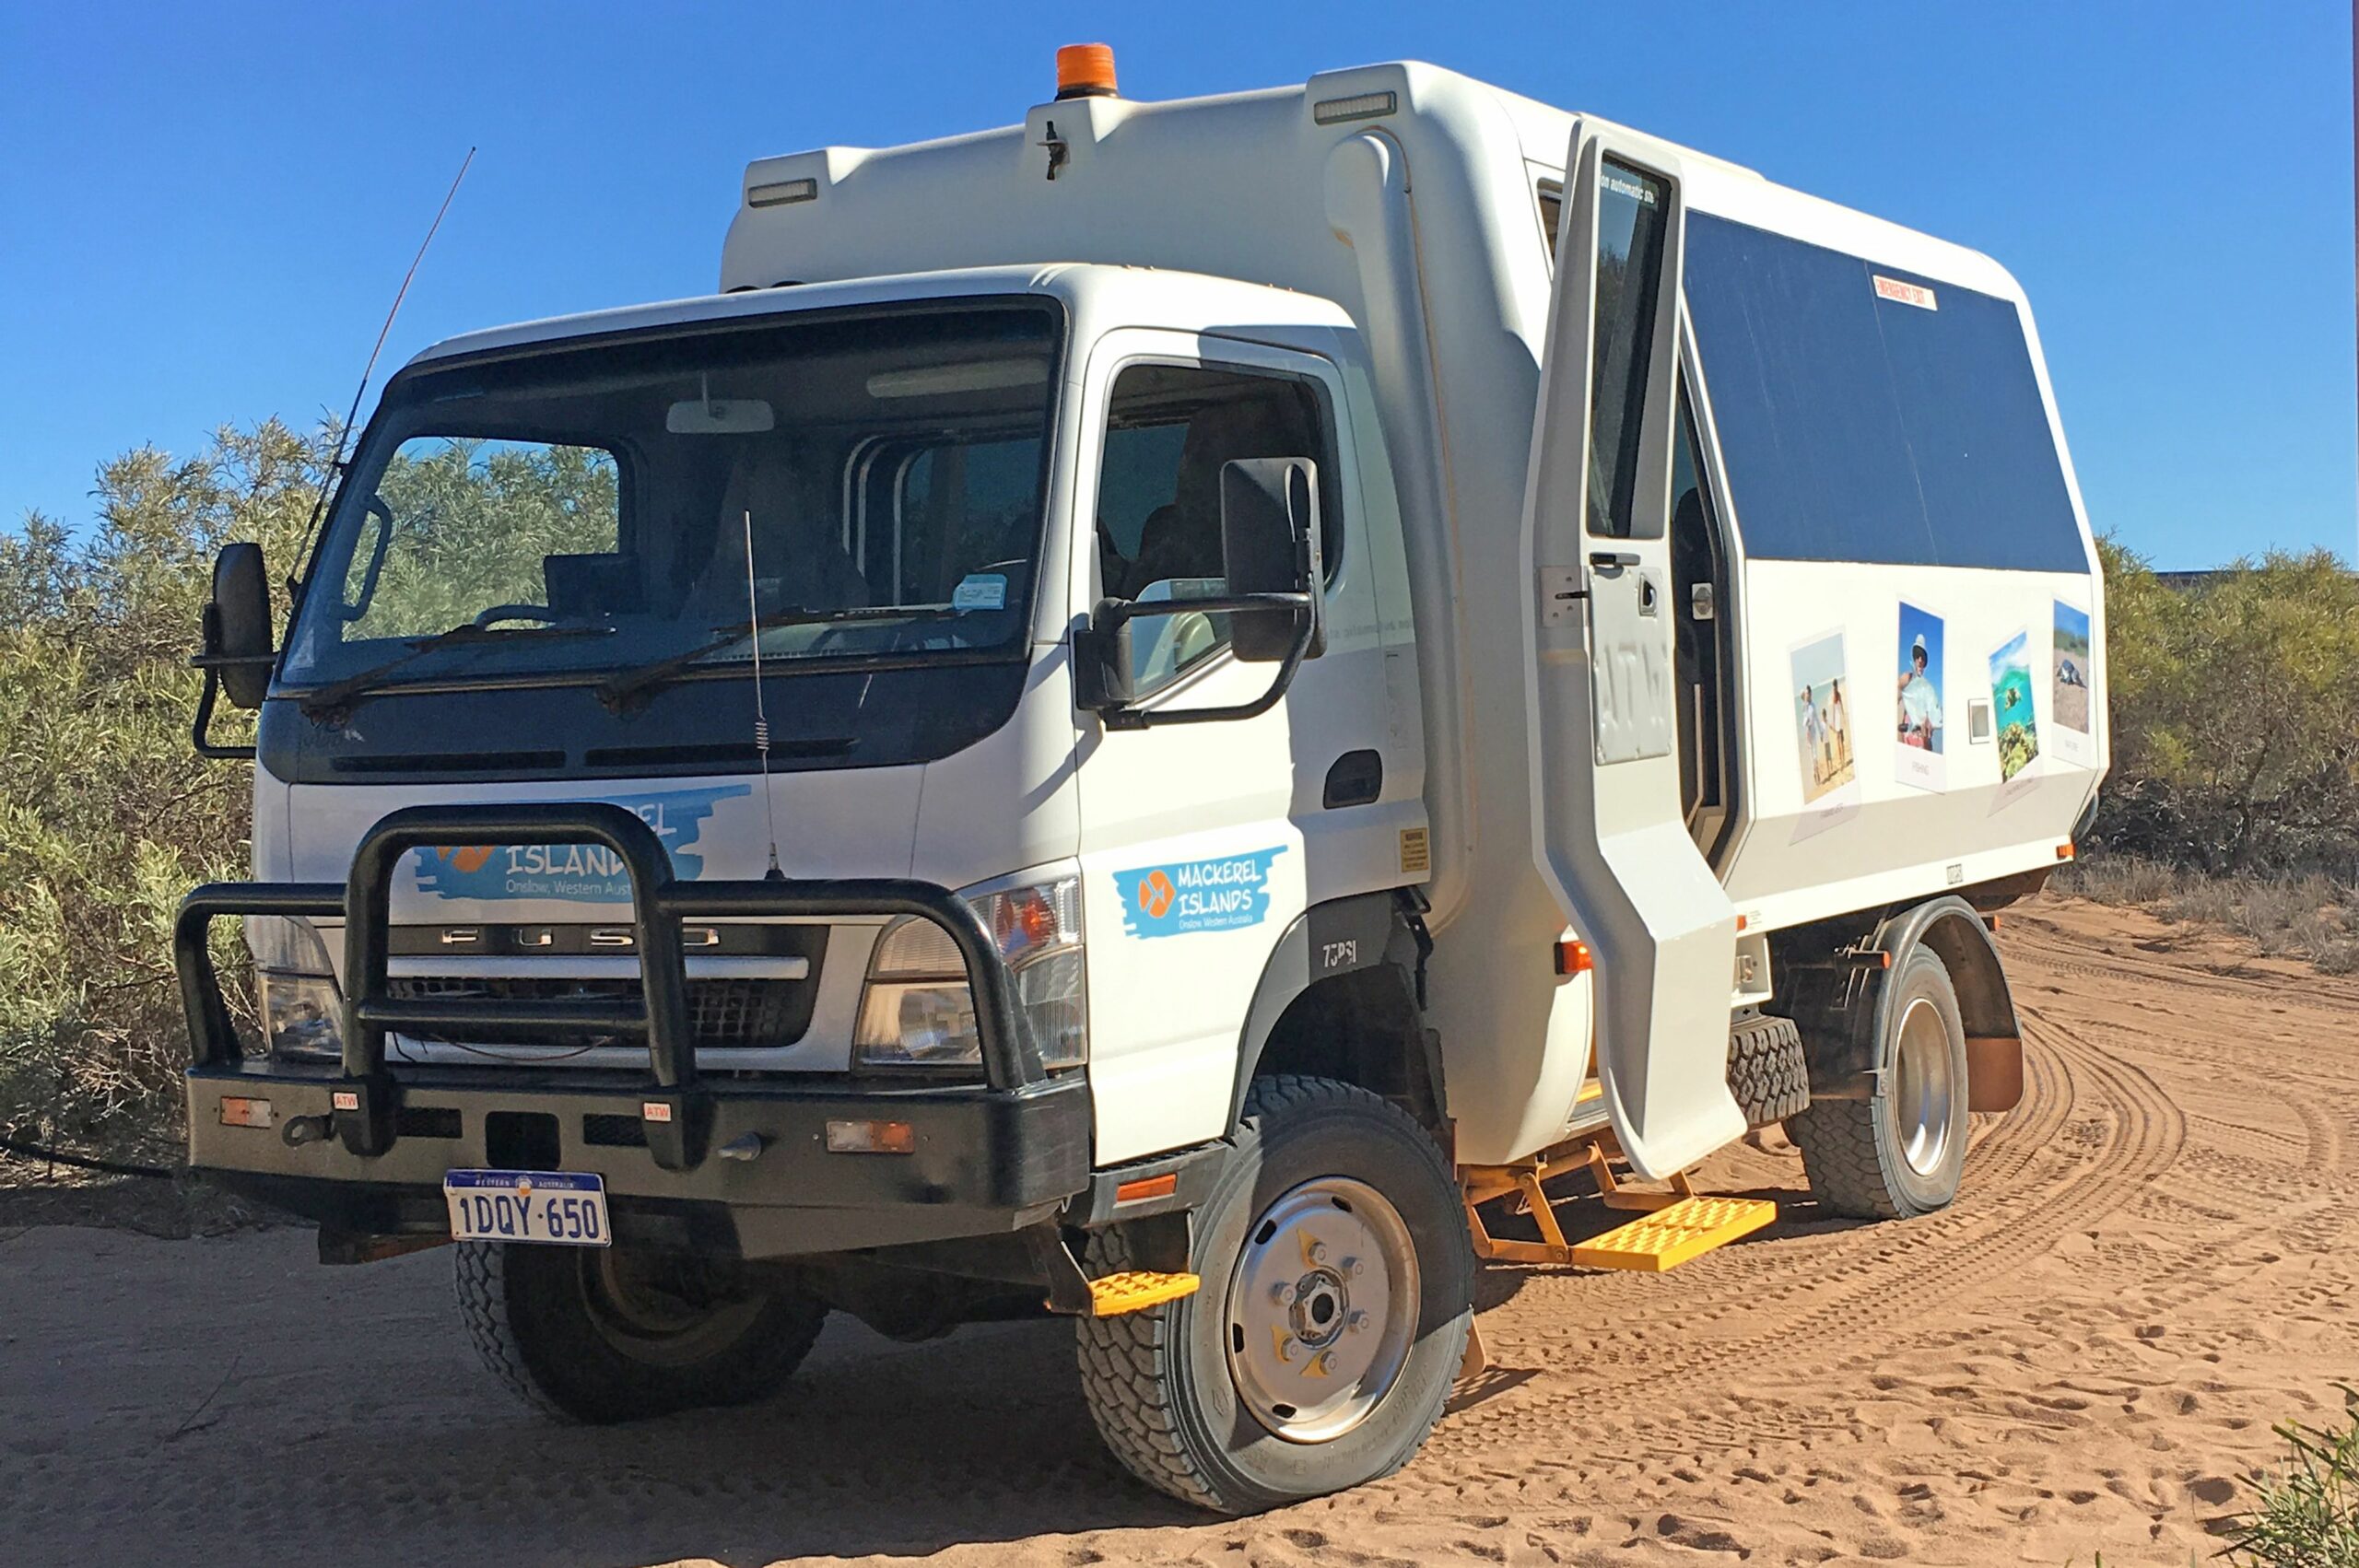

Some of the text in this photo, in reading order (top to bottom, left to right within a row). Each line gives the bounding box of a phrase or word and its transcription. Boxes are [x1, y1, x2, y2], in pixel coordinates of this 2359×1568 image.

[1178, 859, 1262, 888] MACKEREL
[505, 879, 551, 895] Onslow,
[553, 881, 602, 895] Western
[1178, 888, 1253, 918] ISLANDS
[334, 1094, 358, 1106] ATW
[645, 1105, 669, 1117] ATW
[538, 1180, 575, 1189] AUSTRALIA
